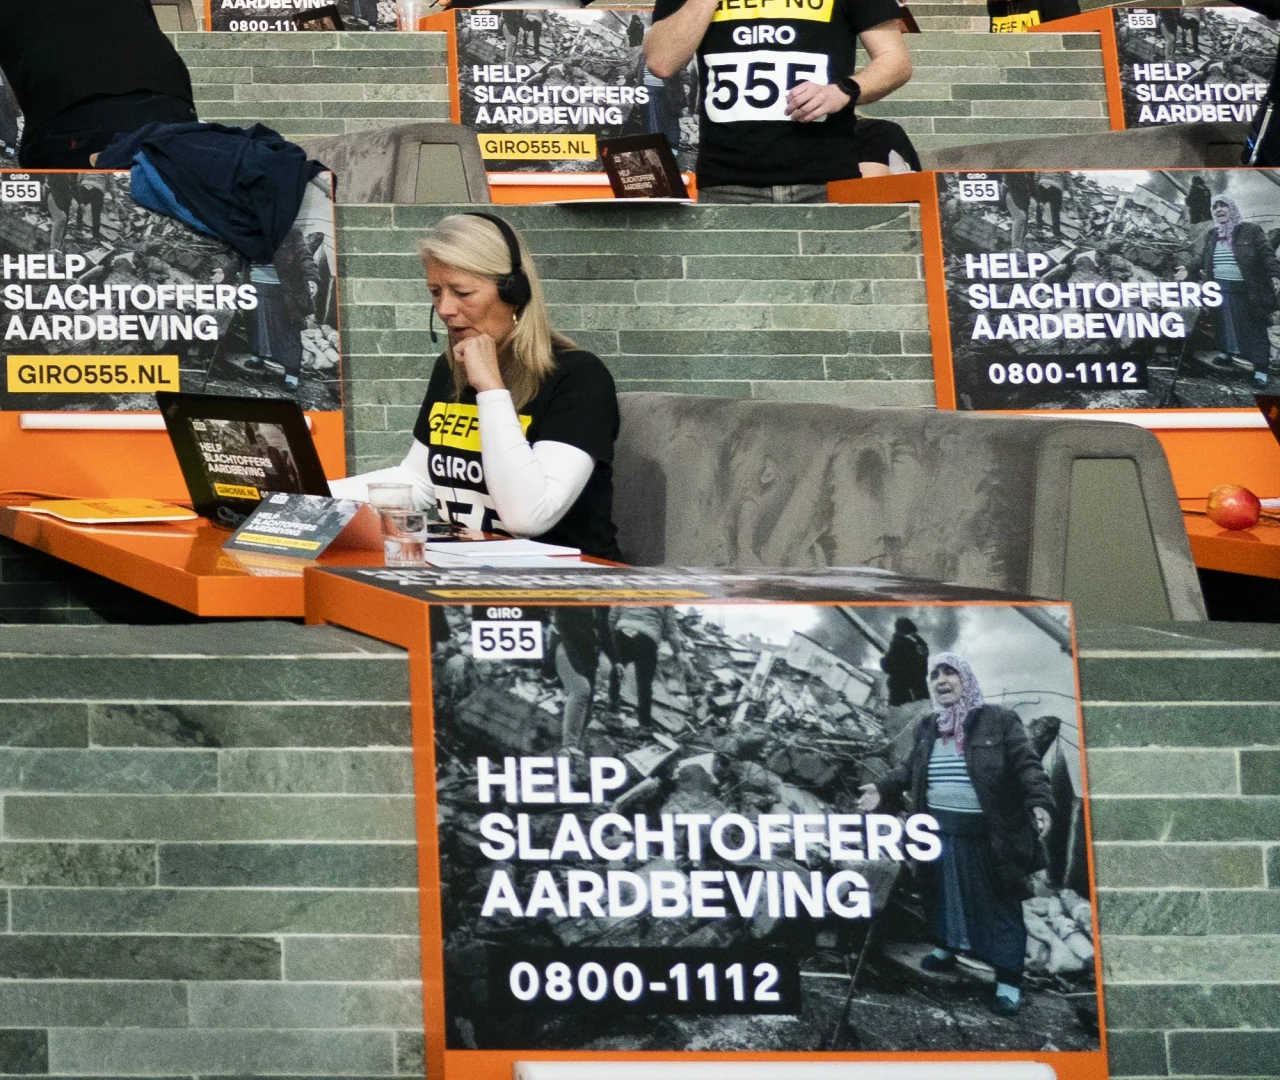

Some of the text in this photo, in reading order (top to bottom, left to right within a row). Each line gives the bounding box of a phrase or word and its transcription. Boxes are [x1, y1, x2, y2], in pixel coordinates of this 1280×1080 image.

[473, 17, 496, 27] 555
[1131, 16, 1154, 26] 555
[732, 25, 796, 46] GIRO
[473, 65, 531, 83] HELP
[1133, 63, 1192, 81] HELP
[474, 85, 650, 104] SLACHTOFFERS
[1136, 83, 1270, 102] SLACHTOFF
[475, 107, 623, 125] AARDBEVING
[1138, 104, 1257, 122] AARDBEVI
[485, 140, 591, 154] GIRO555.NL
[10, 173, 30, 181] GIRO
[5, 184, 38, 199] 555
[963, 183, 996, 198] 555
[3, 253, 86, 280] HELP
[965, 253, 1048, 279] HELP
[4, 283, 258, 310] SLACHTOFFERS
[968, 281, 1223, 309] SLACHTOFFERS
[4, 314, 219, 341] AARDBEVING
[971, 312, 1186, 339] AARDBEVING
[18, 364, 171, 385] GIRO555.NL
[989, 362, 1137, 384] 0800-1112
[430, 413, 479, 438] GEEF
[200, 442, 222, 453] HELP
[203, 452, 273, 468] SLACHTOFFERS
[431, 454, 483, 484] GIRO
[208, 463, 266, 478] AARDBEVING
[486, 607, 522, 619] GIRO
[478, 627, 536, 652] 555
[477, 756, 626, 803] HELP
[479, 813, 942, 862] SLACHTOFFERS
[481, 870, 871, 918] AARDBEVING
[509, 962, 781, 1002] 0800-1112
